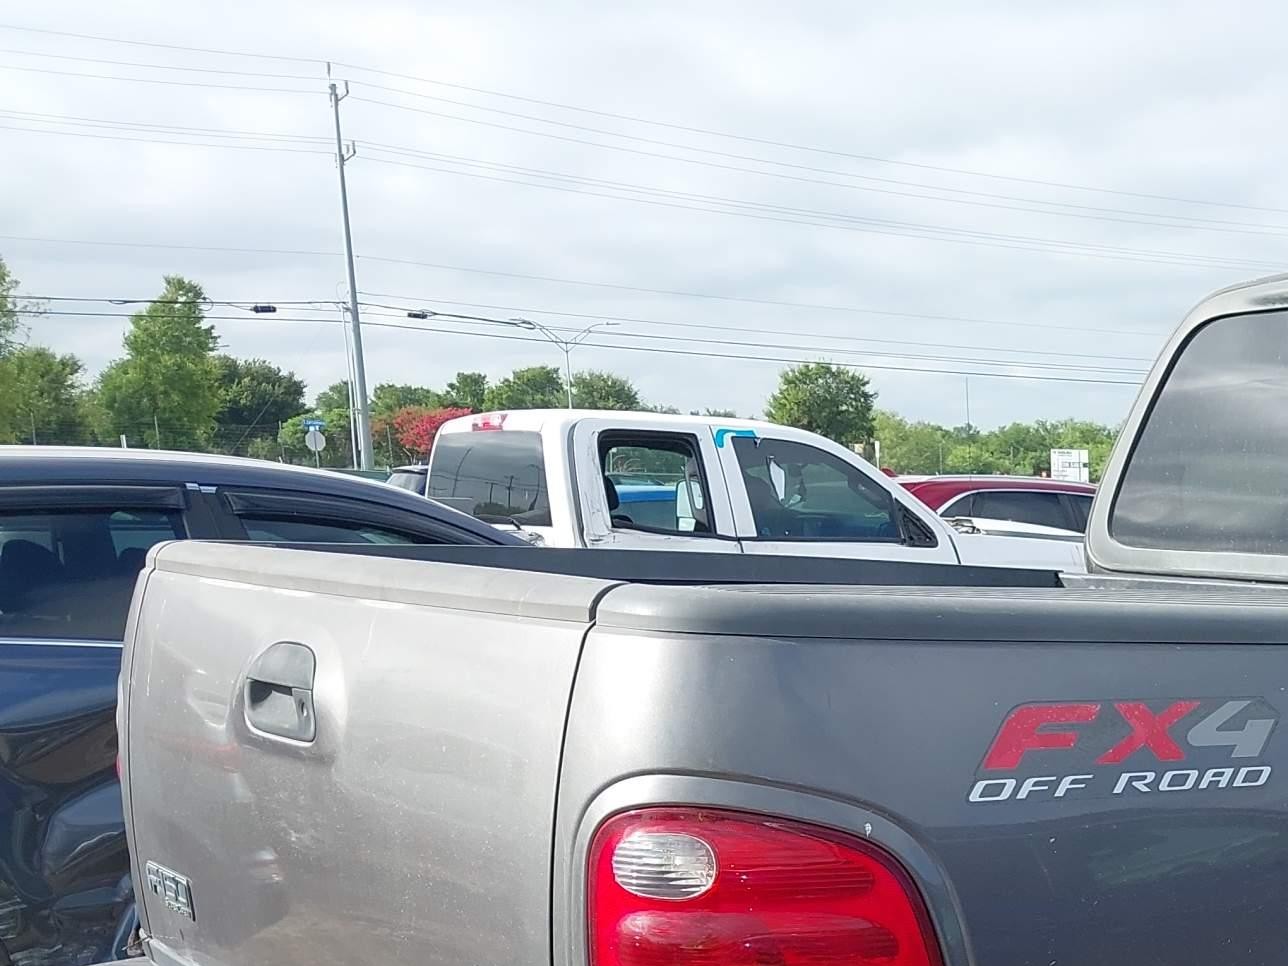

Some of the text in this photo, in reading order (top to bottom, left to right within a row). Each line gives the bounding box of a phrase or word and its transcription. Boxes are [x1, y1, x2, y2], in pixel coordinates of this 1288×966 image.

[984, 700, 1275, 771] FX4
[969, 766, 1272, 802] OFF ROAD
